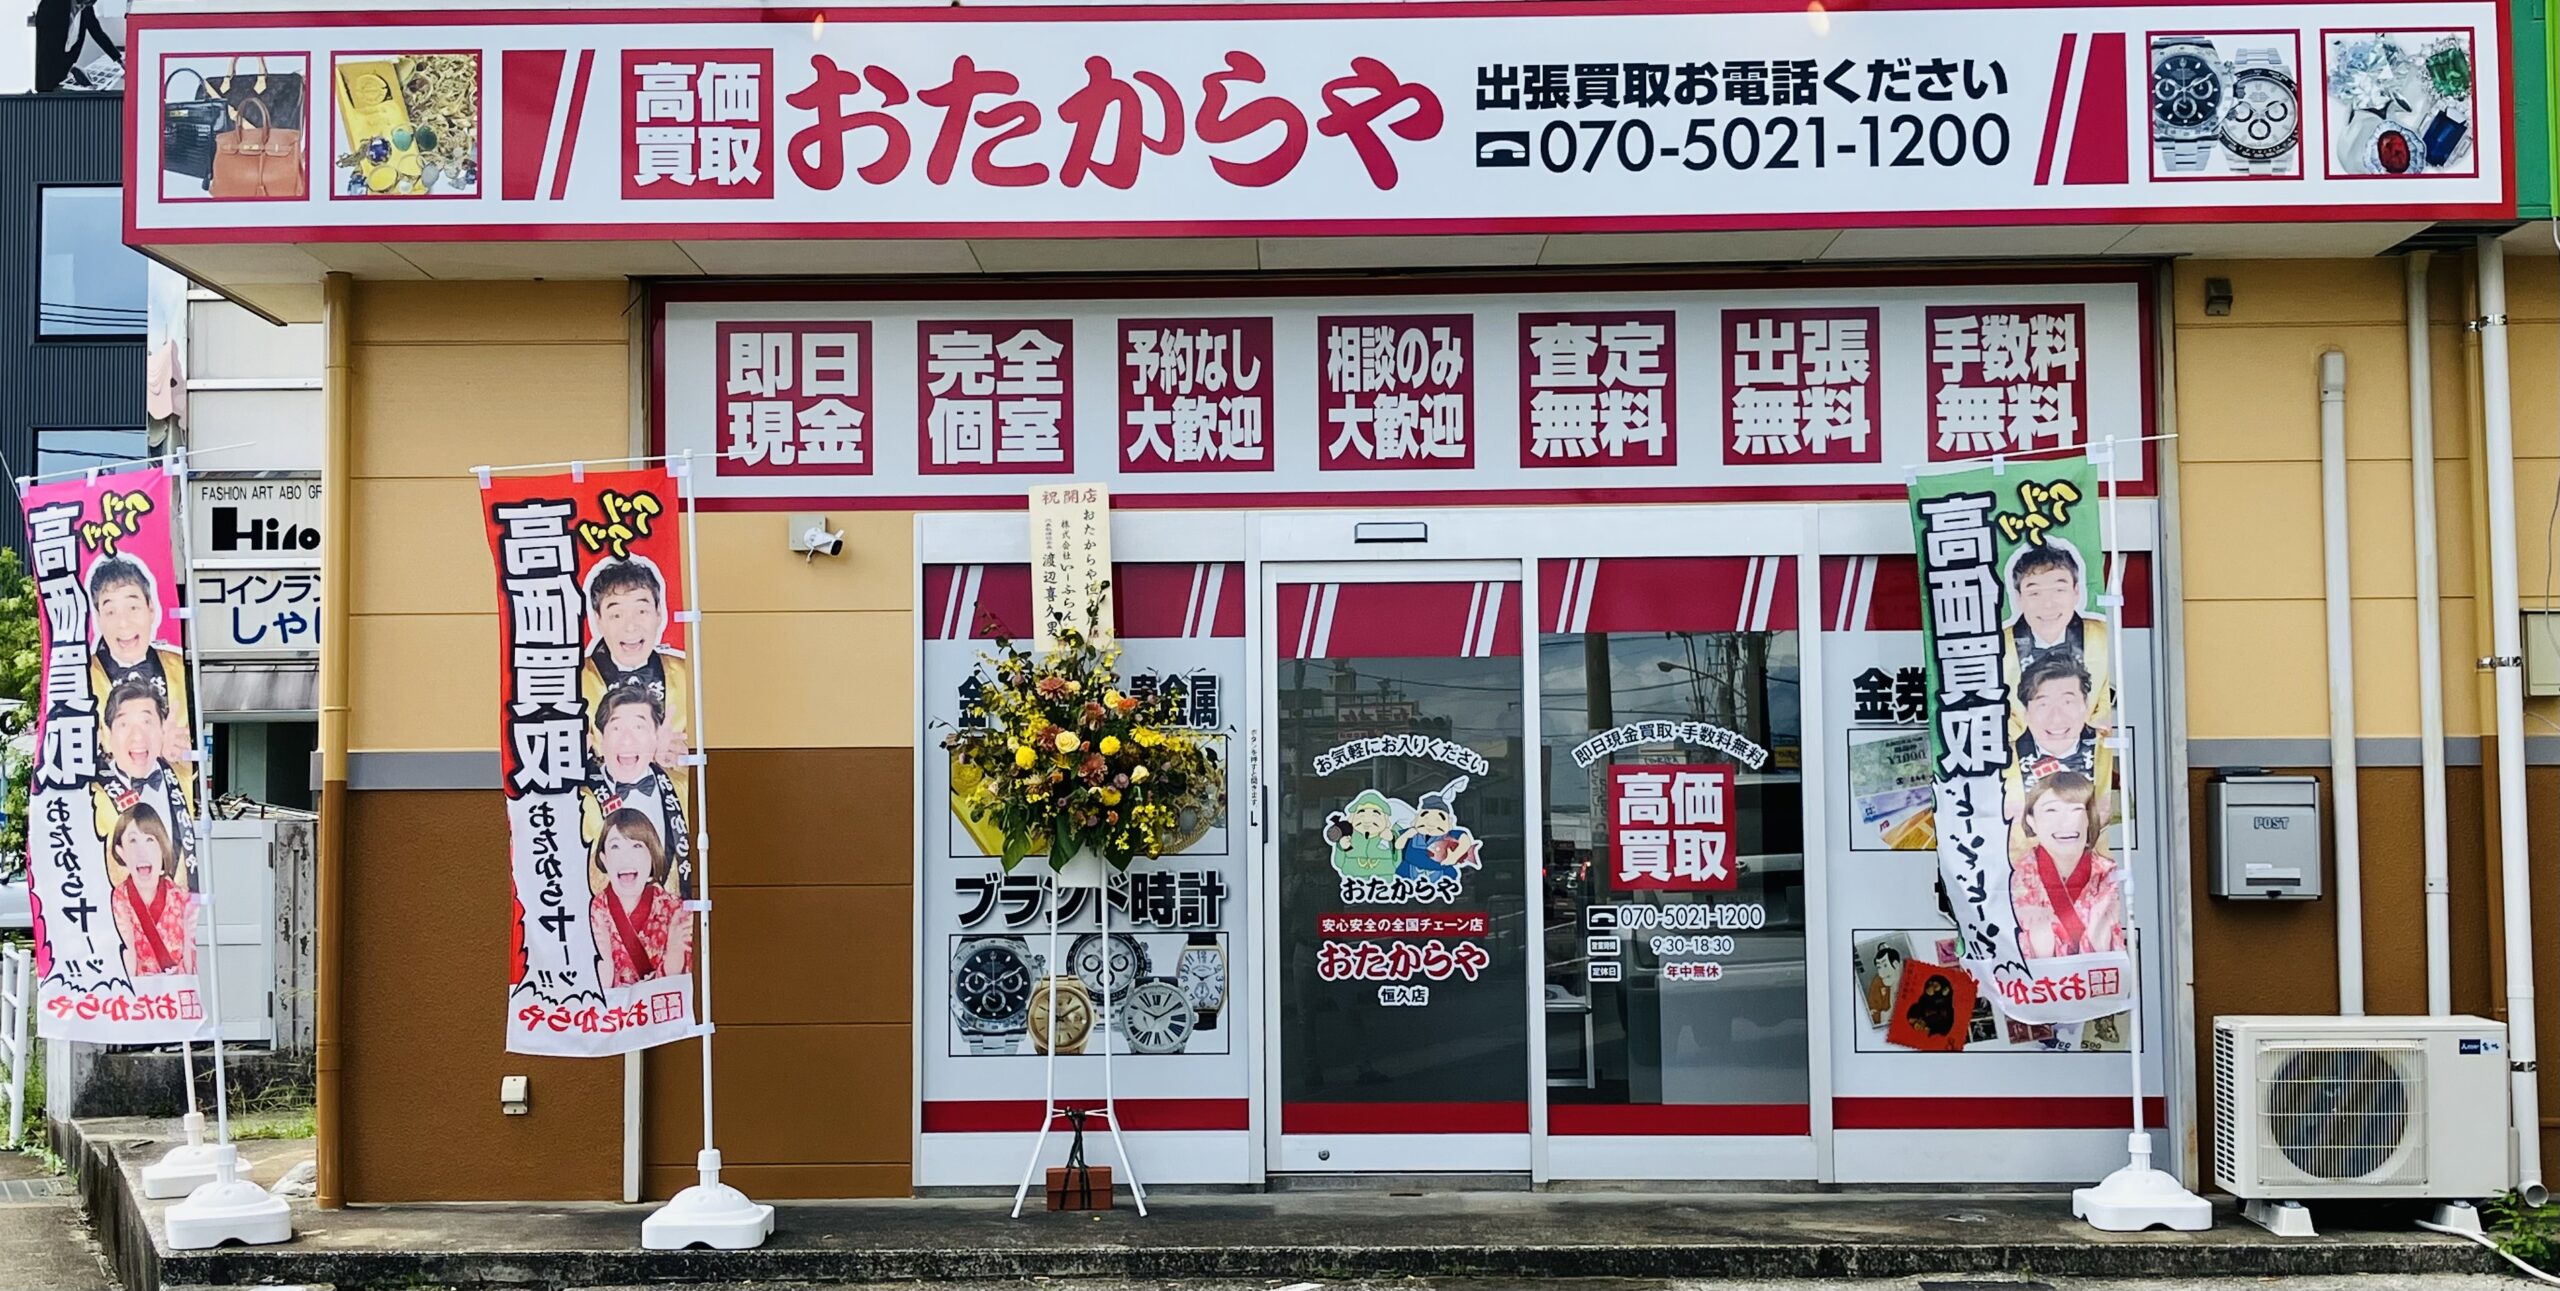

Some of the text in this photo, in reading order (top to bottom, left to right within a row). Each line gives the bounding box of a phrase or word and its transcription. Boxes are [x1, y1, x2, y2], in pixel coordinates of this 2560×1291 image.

[633, 61, 761, 122] 高価
[1475, 59, 2008, 111] 出張買取お電話ください
[785, 50, 1444, 191] おたからや
[1539, 114, 2010, 173] 070-5021-1200
[634, 126, 762, 186] 買取
[728, 332, 859, 397] 即日
[928, 331, 1064, 396] 完全
[1126, 328, 1262, 394] 予約なし
[1327, 326, 1464, 391] 相談のみ
[1530, 322, 1668, 388] 査定
[1734, 319, 1870, 385] 出張
[1932, 314, 2079, 383] 手数料
[728, 400, 866, 466] 現金
[928, 400, 1064, 464] 個室
[1127, 396, 1265, 463] 大歓迎
[1327, 394, 1466, 461] 大歓迎
[1530, 390, 1668, 459] 無料
[1732, 386, 1870, 456] 無料
[1936, 383, 2078, 453] 無料
[201, 486, 247, 501] FASHION
[251, 485, 273, 500] ART
[279, 485, 301, 499] ABO
[1042, 488, 1097, 505] 祝開店
[199, 575, 321, 604] コインラ
[1042, 553, 1059, 637] 渡辺喜久男
[1315, 736, 1488, 776] お気軽にお入りください
[1616, 771, 1724, 826] 高価
[2254, 816, 2290, 830] POST
[1619, 830, 1727, 882] 買取
[1342, 878, 1462, 903] おたからや
[1621, 906, 1763, 927] 070-5021-1200
[1322, 917, 1484, 933] 安心安全の全国チェーン店
[1319, 942, 1488, 979] おたからや
[1592, 967, 1617, 977] 定休日
[1666, 965, 1720, 978] 年中無休
[1381, 988, 1427, 1003] 恒久店
